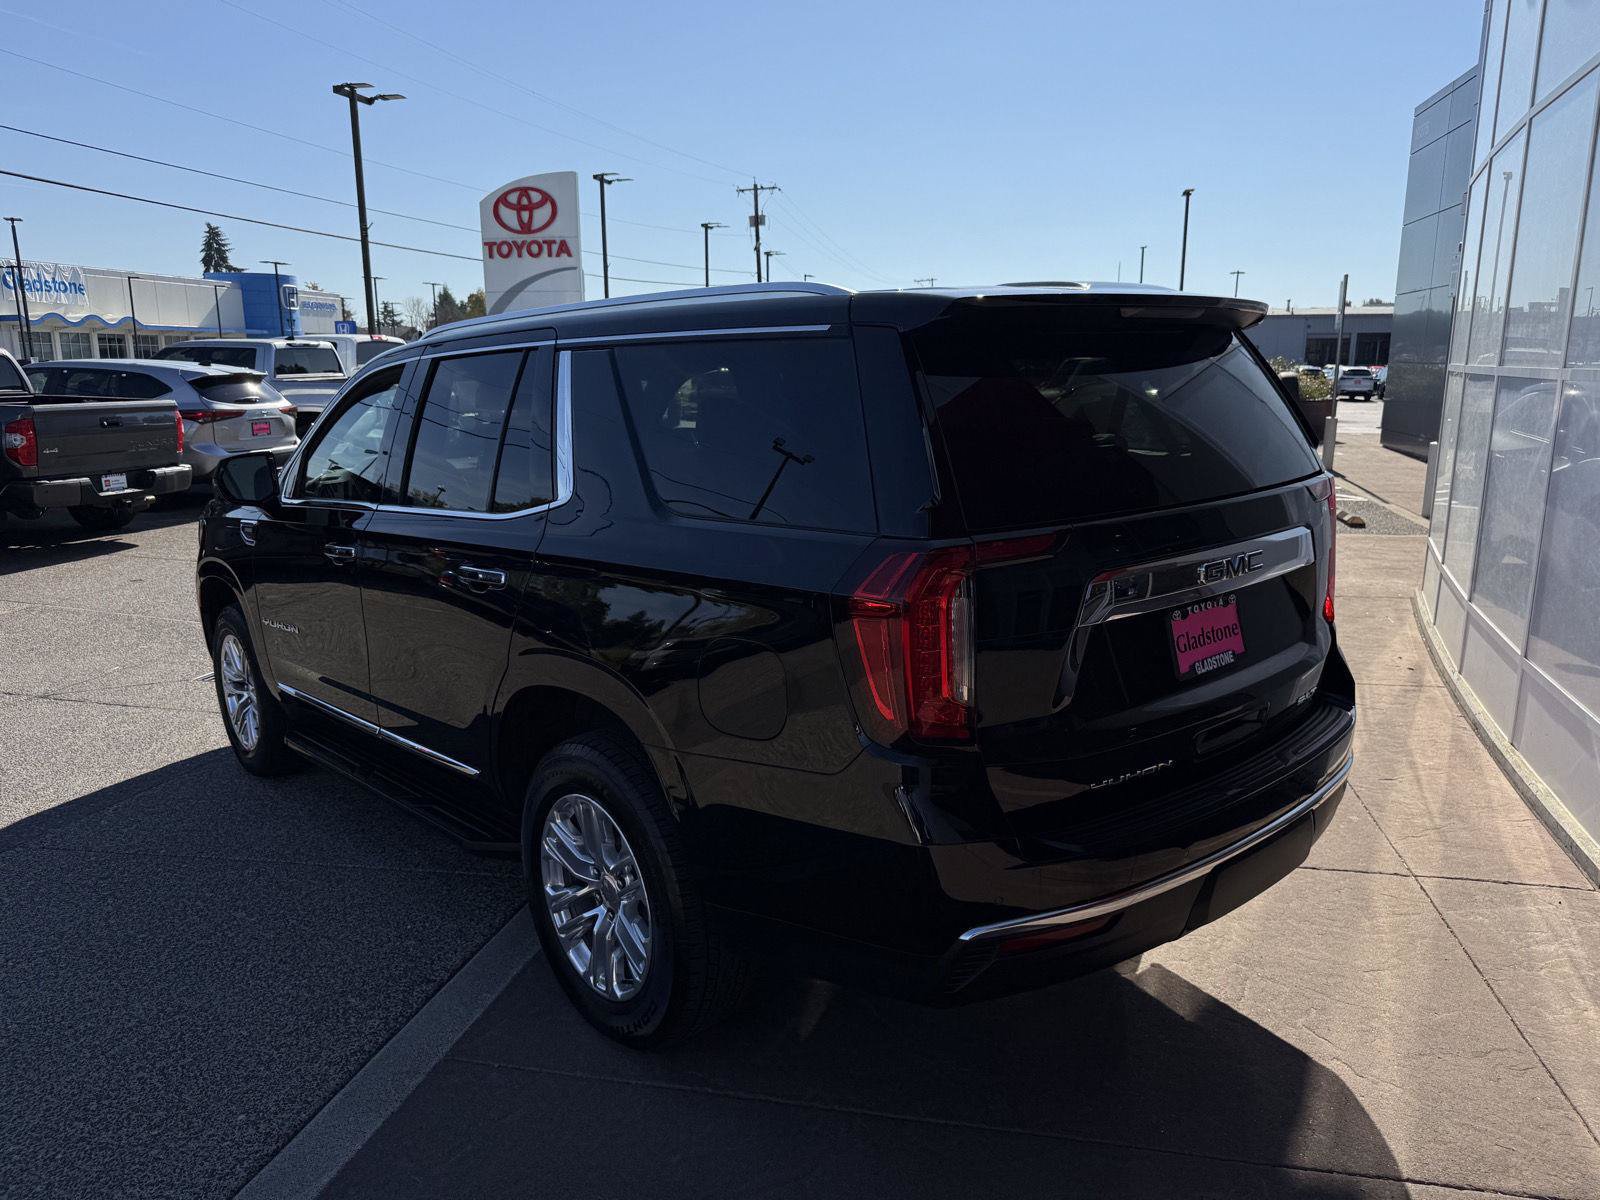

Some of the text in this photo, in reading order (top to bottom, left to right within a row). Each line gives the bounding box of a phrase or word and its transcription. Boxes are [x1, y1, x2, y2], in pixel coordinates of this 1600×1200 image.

[483, 239, 573, 259] TOYOTA
[2, 270, 86, 296] Gadstone
[1197, 549, 1264, 585] GMC
[1187, 598, 1224, 615] TOYOTA
[262, 617, 299, 634] YUKON
[1176, 622, 1239, 654] Gladstone
[1194, 650, 1235, 675] GLADSTONE
